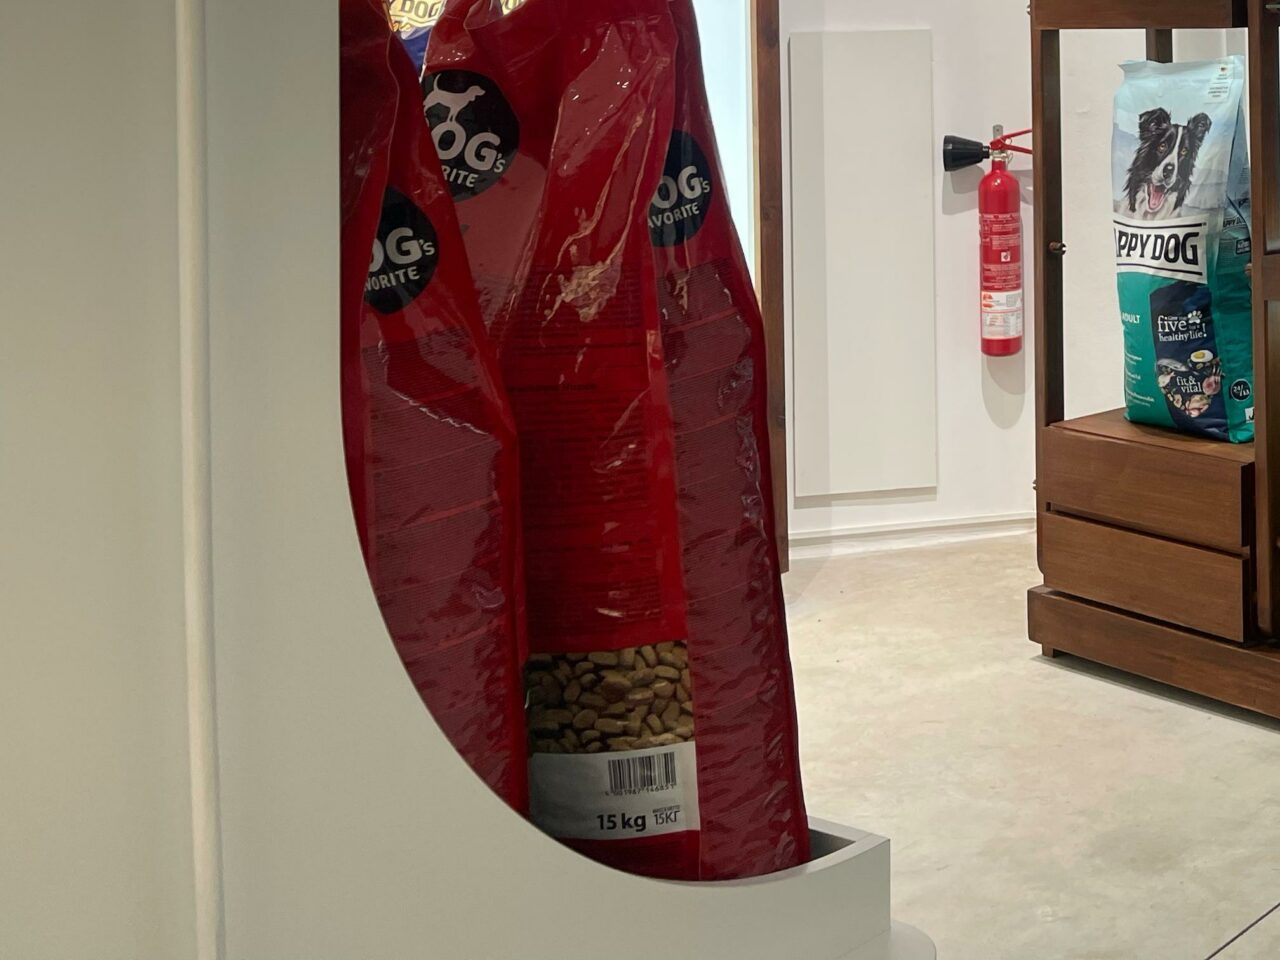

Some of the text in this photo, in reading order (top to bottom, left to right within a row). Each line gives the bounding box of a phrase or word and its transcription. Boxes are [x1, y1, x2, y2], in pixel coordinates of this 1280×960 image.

[430, 121, 506, 174] OG's
[653, 165, 711, 209] OG's
[1151, 231, 1199, 266] DOG
[364, 265, 420, 290] VORITE
[1158, 315, 1187, 332] five
[1159, 332, 1190, 342] healthy
[1177, 376, 1188, 386] fit
[1181, 381, 1202, 393] vital
[597, 812, 647, 833] 15 kg
